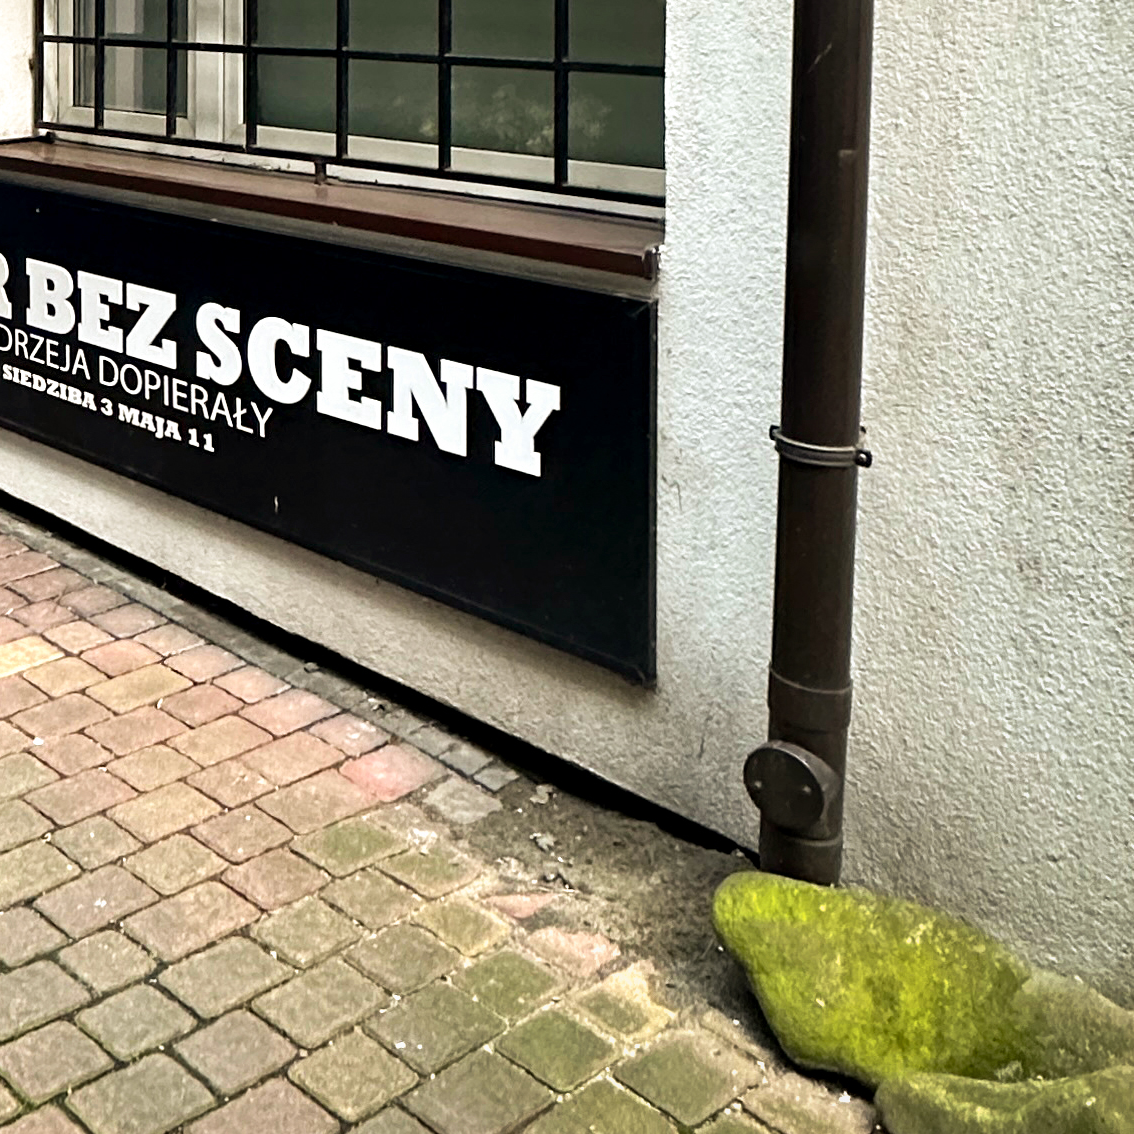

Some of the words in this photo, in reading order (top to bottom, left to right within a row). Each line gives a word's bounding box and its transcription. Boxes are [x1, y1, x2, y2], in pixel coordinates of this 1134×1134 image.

[2, 364, 97, 412] SIEDZIBA
[100, 398, 114, 417] 3
[118, 403, 182, 440] MAJA
[188, 428, 215, 452] 11
[26, 257, 177, 369] BEZ
[195, 302, 561, 478] SCENY
[98, 355, 273, 438] DOPIERAŁY
